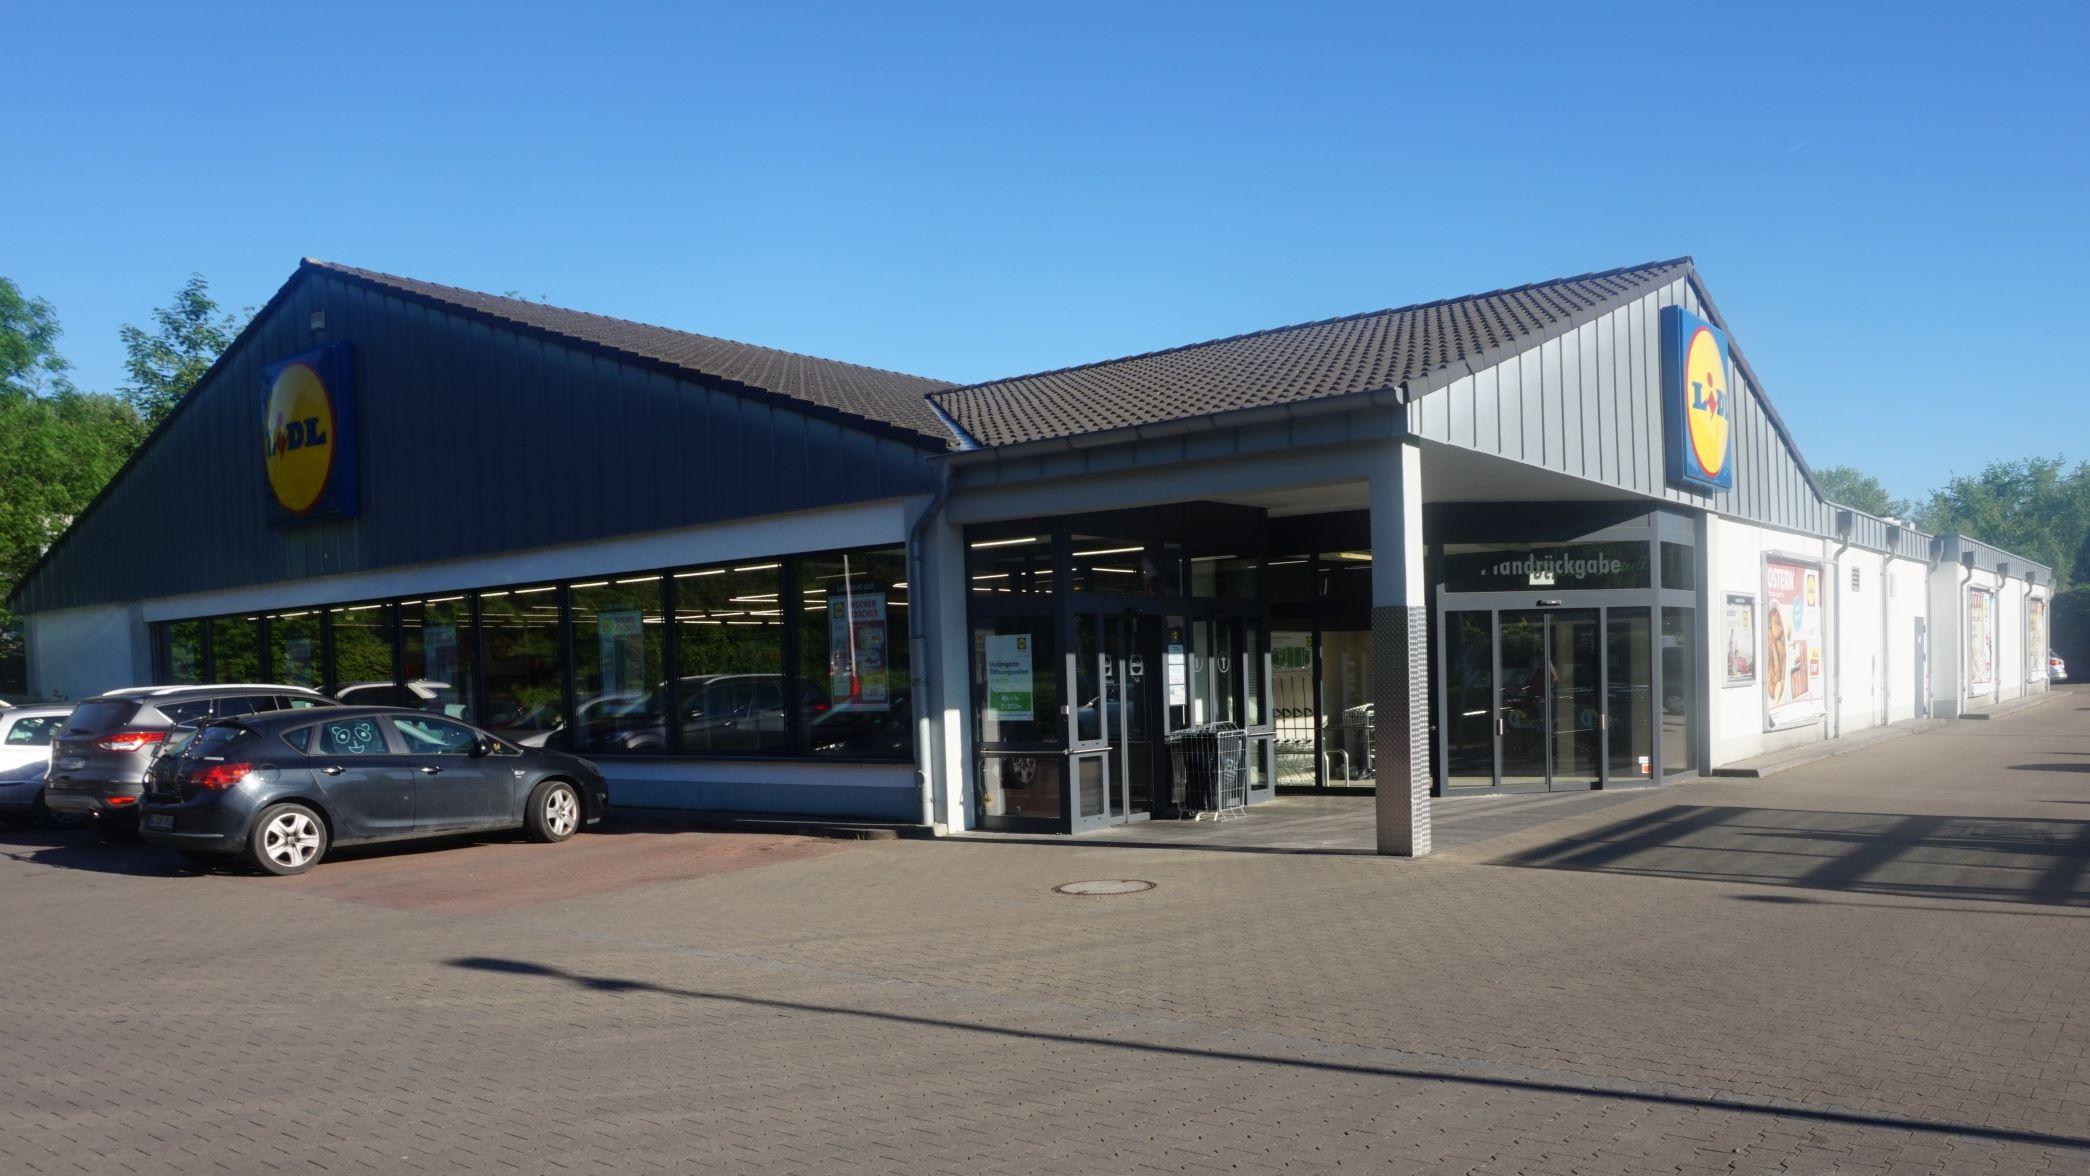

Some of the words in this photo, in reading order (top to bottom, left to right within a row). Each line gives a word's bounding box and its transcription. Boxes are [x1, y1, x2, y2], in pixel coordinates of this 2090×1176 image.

[1691, 371, 1729, 420] LID
[1480, 552, 1621, 580] andrückgabe
[1767, 566, 1795, 591] OSTERN
